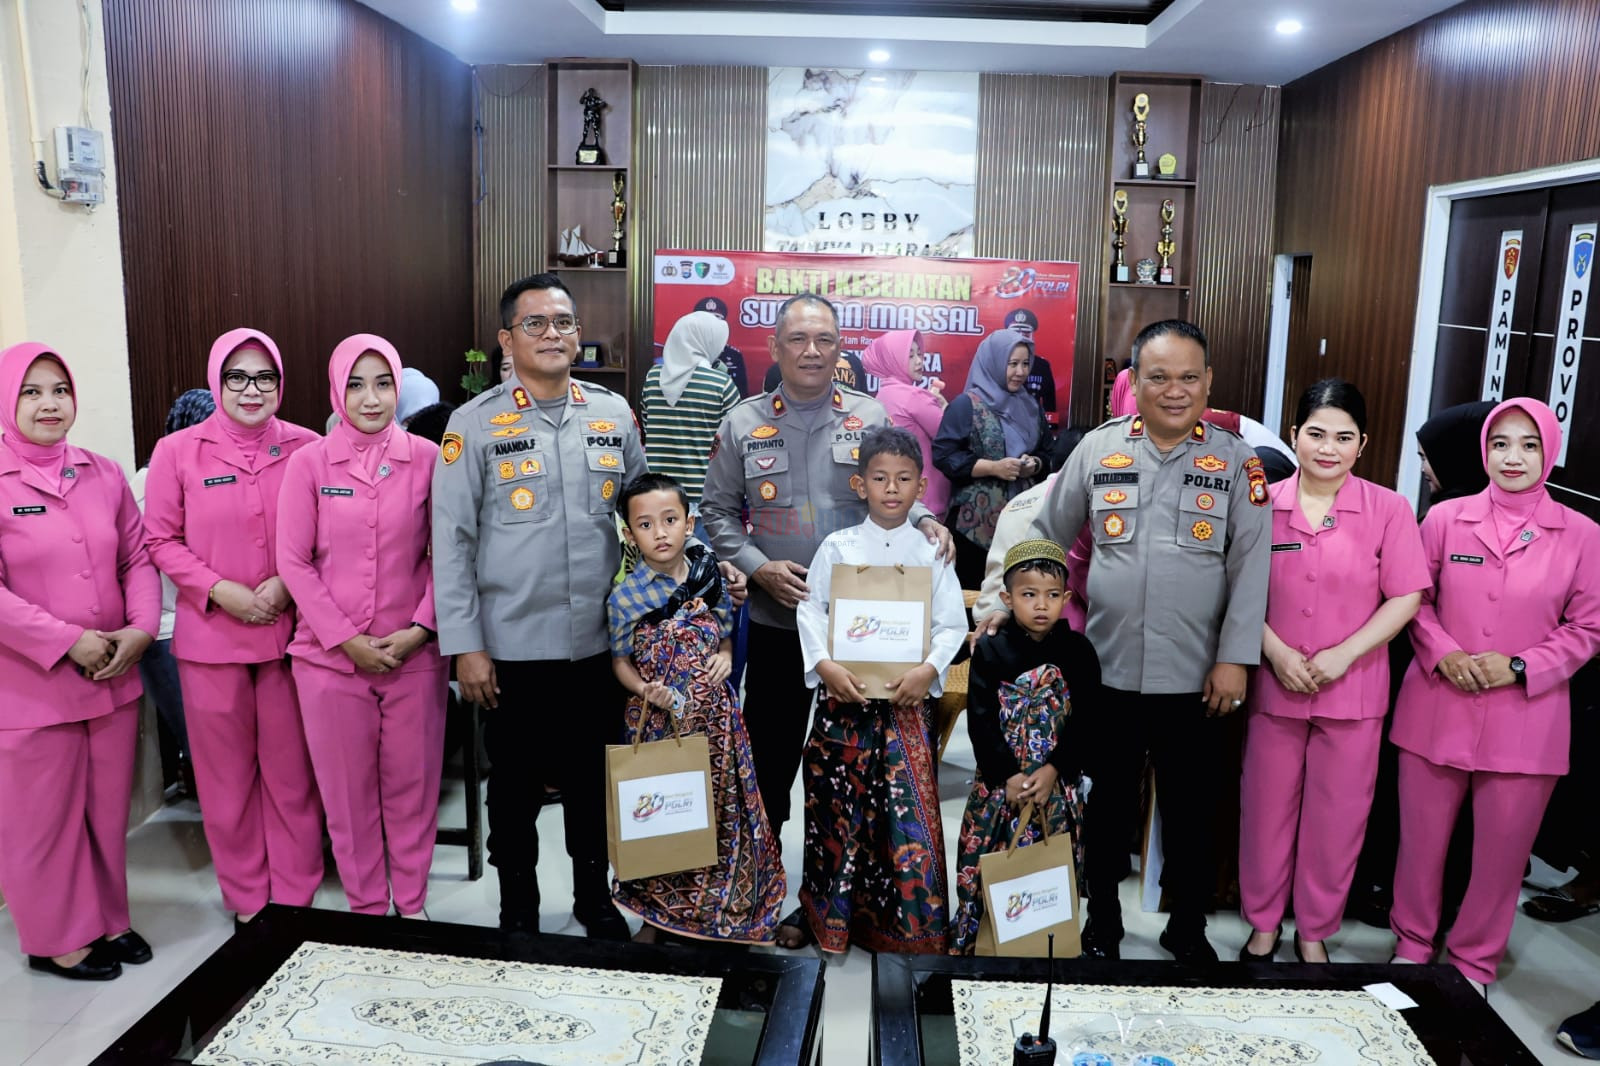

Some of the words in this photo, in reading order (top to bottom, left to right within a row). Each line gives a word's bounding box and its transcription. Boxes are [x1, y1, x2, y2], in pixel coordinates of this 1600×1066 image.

[818, 212, 920, 231] LOBBY
[756, 268, 829, 294] BAKTI
[835, 270, 971, 301] KESEHATAN
[1034, 280, 1070, 292] POLRI
[868, 302, 984, 335] MASSAL
[587, 436, 622, 448] POLRI
[747, 439, 785, 451] PRIYANTO
[1184, 473, 1231, 492] POLRI
